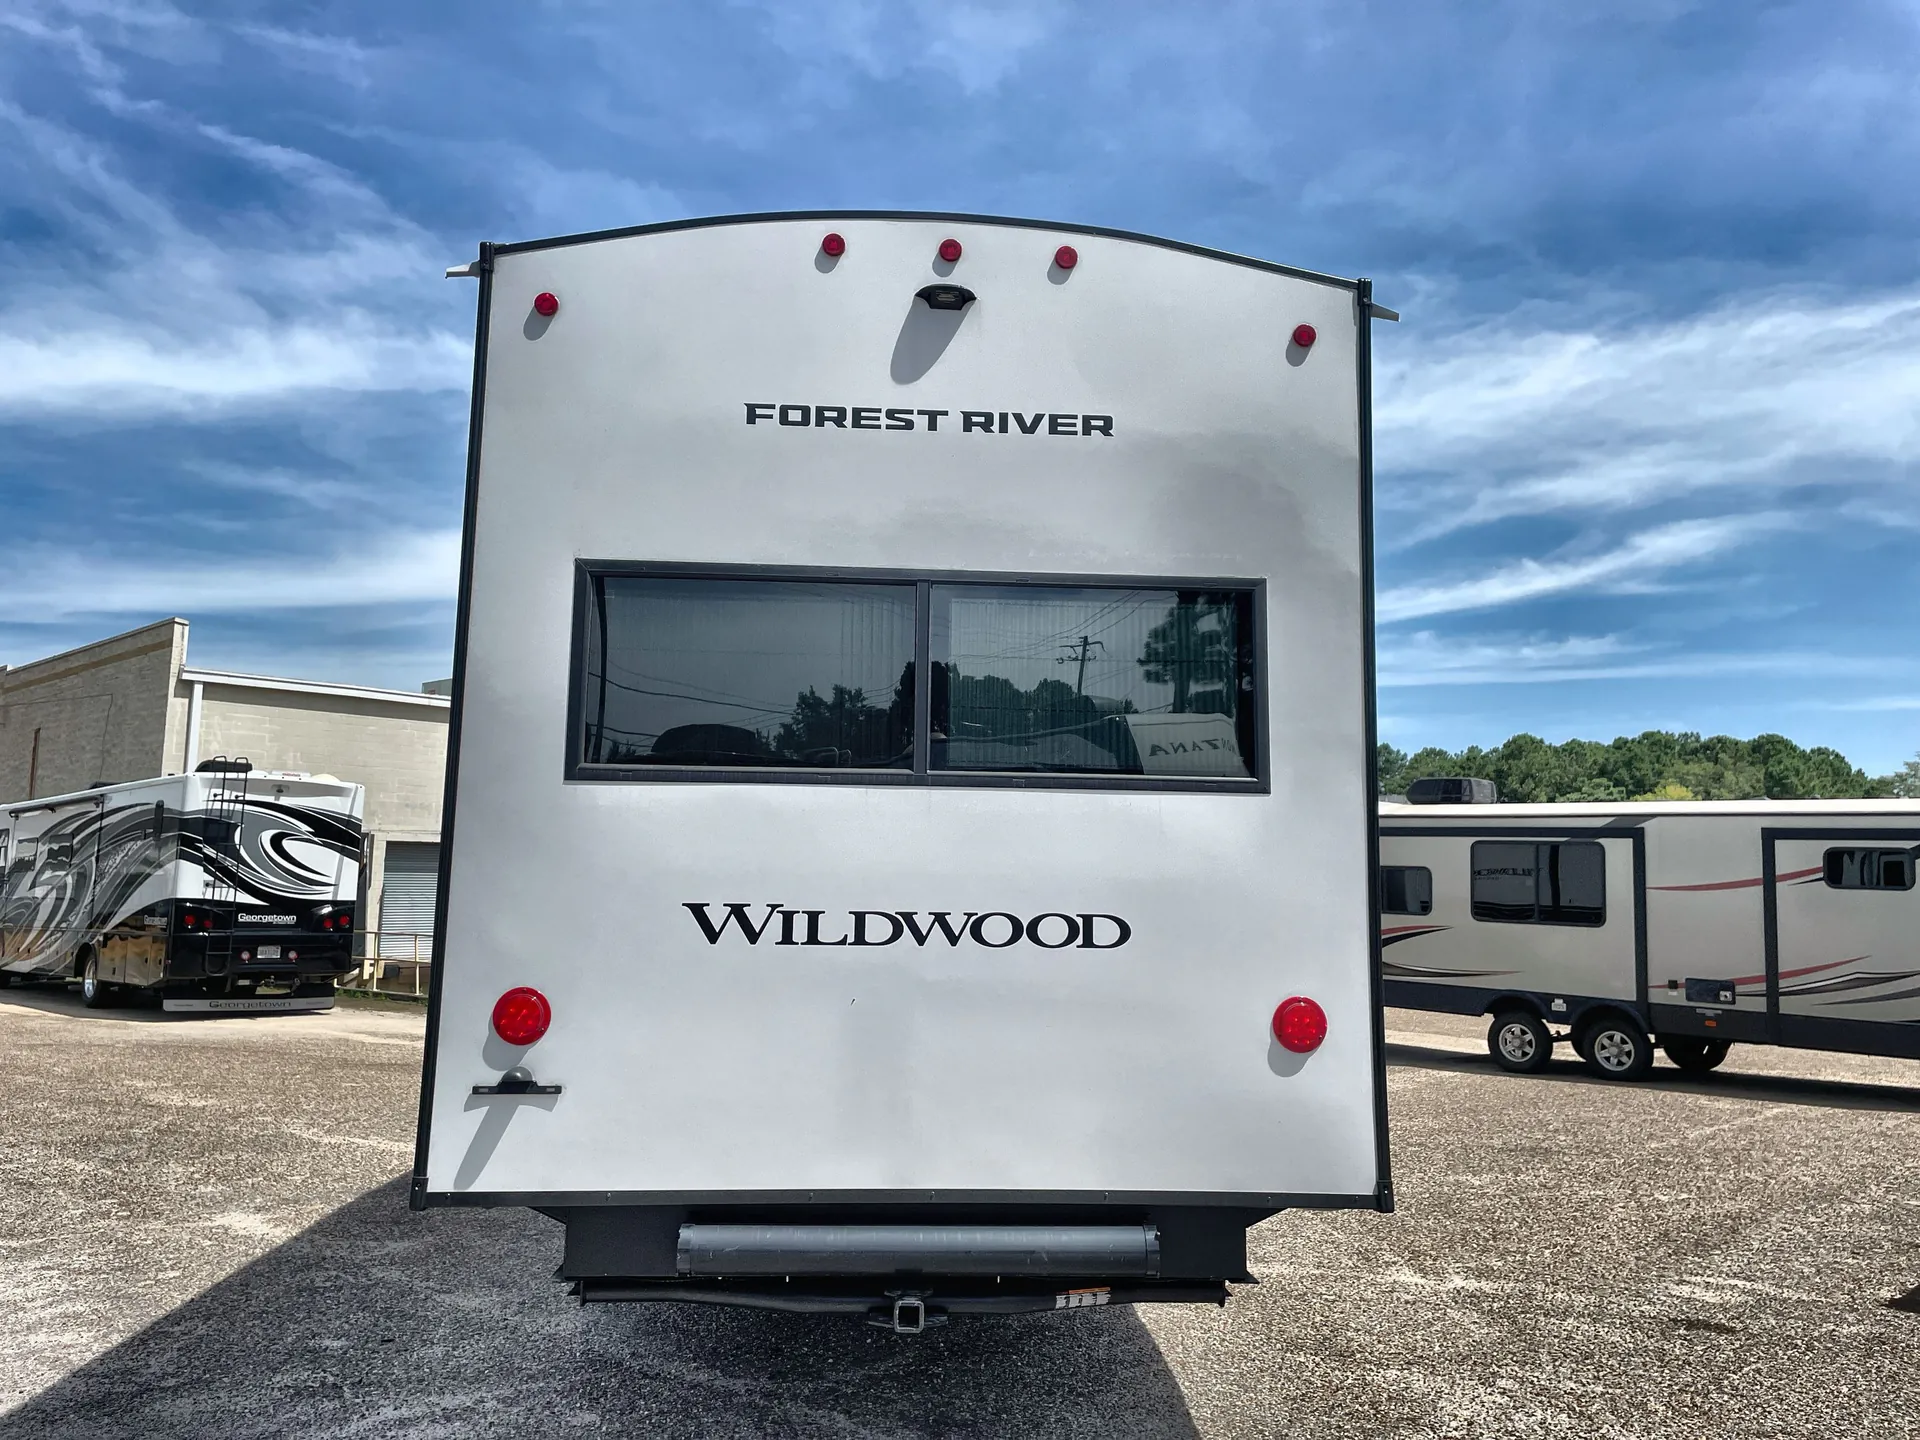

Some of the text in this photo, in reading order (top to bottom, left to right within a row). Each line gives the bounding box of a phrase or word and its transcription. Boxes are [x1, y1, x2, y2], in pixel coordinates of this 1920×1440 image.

[743, 402, 1115, 437] FOREST RIVER
[238, 912, 297, 923] Georgetown
[681, 902, 1132, 949] WILDWOOD
[209, 1000, 291, 1009] Georgetown
